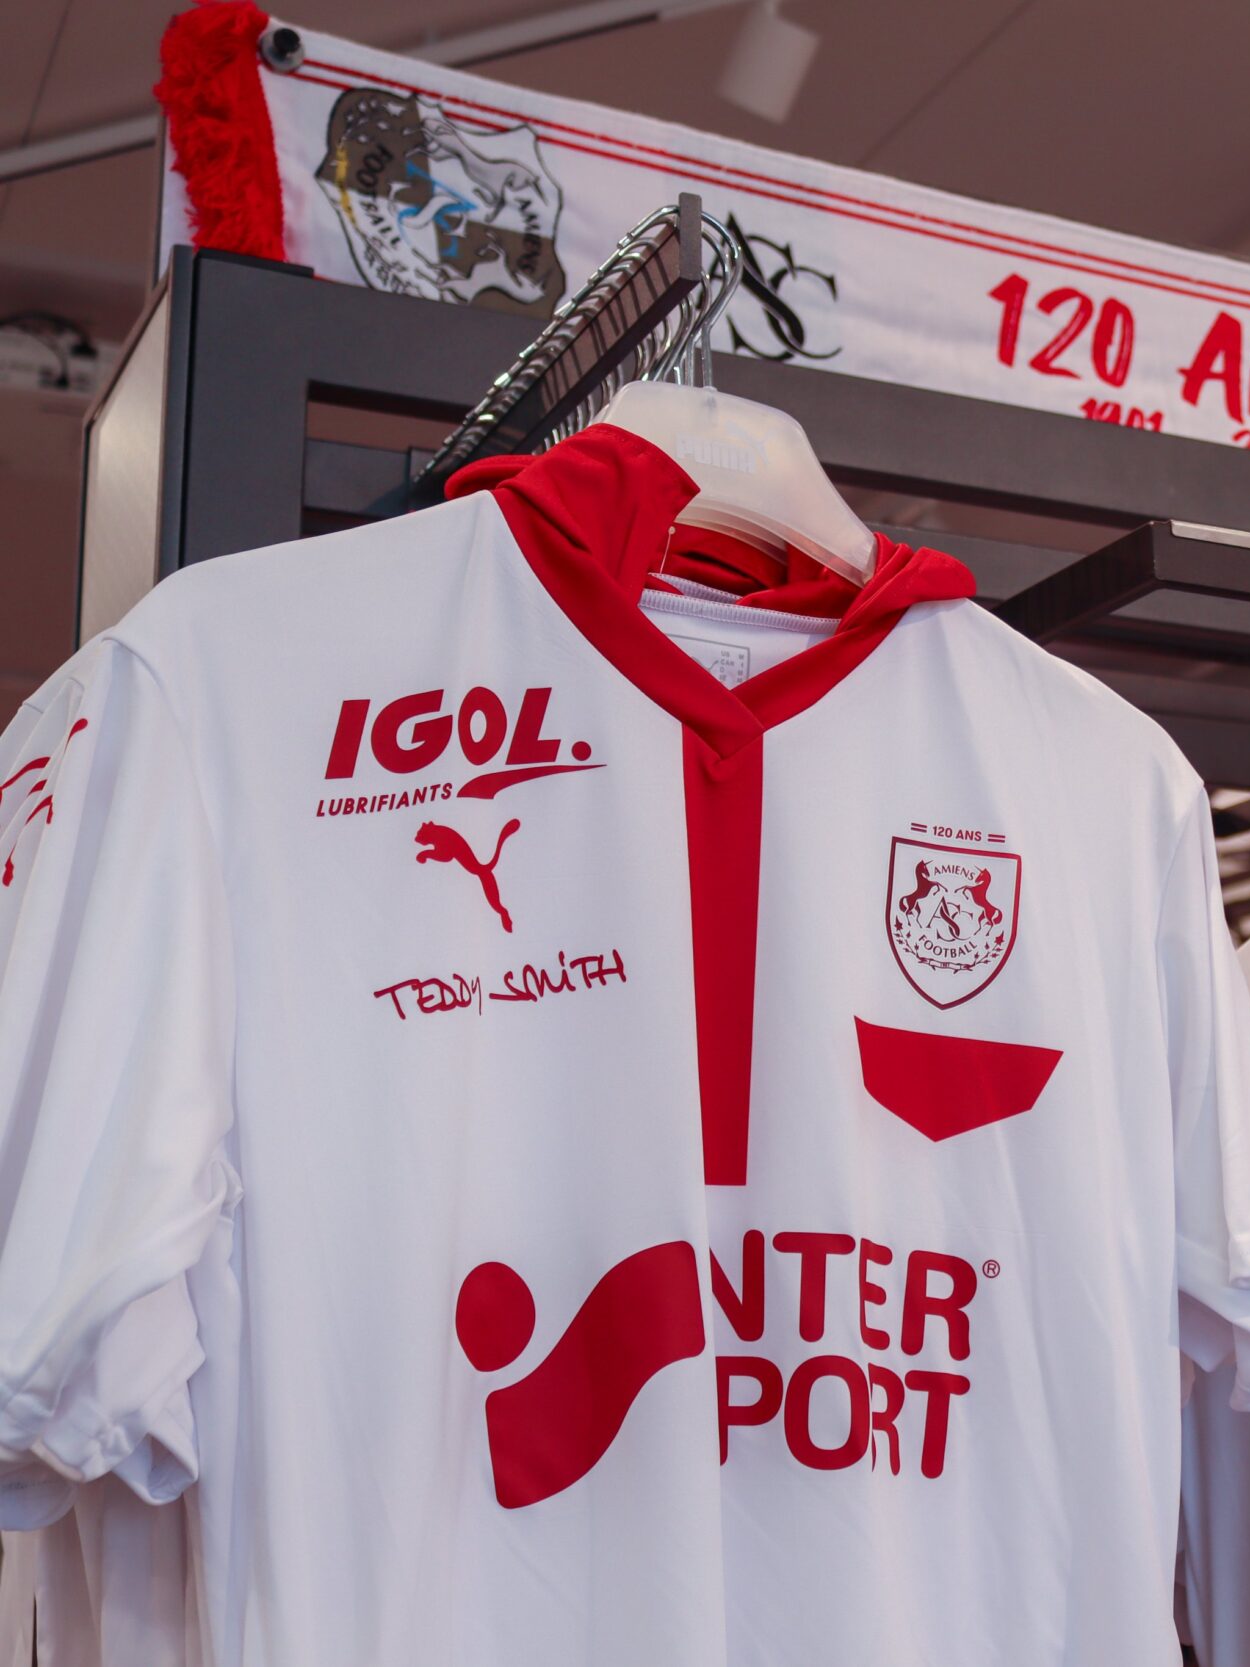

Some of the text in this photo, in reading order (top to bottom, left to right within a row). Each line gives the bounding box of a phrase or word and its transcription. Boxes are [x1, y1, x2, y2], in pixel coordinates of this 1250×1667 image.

[988, 272, 1135, 389] 120
[316, 782, 453, 817] LUBRIFIANTS
[932, 826, 982, 842] 120 ANS
[933, 864, 976, 881] AMIENS
[918, 934, 978, 959] FOOTBALL
